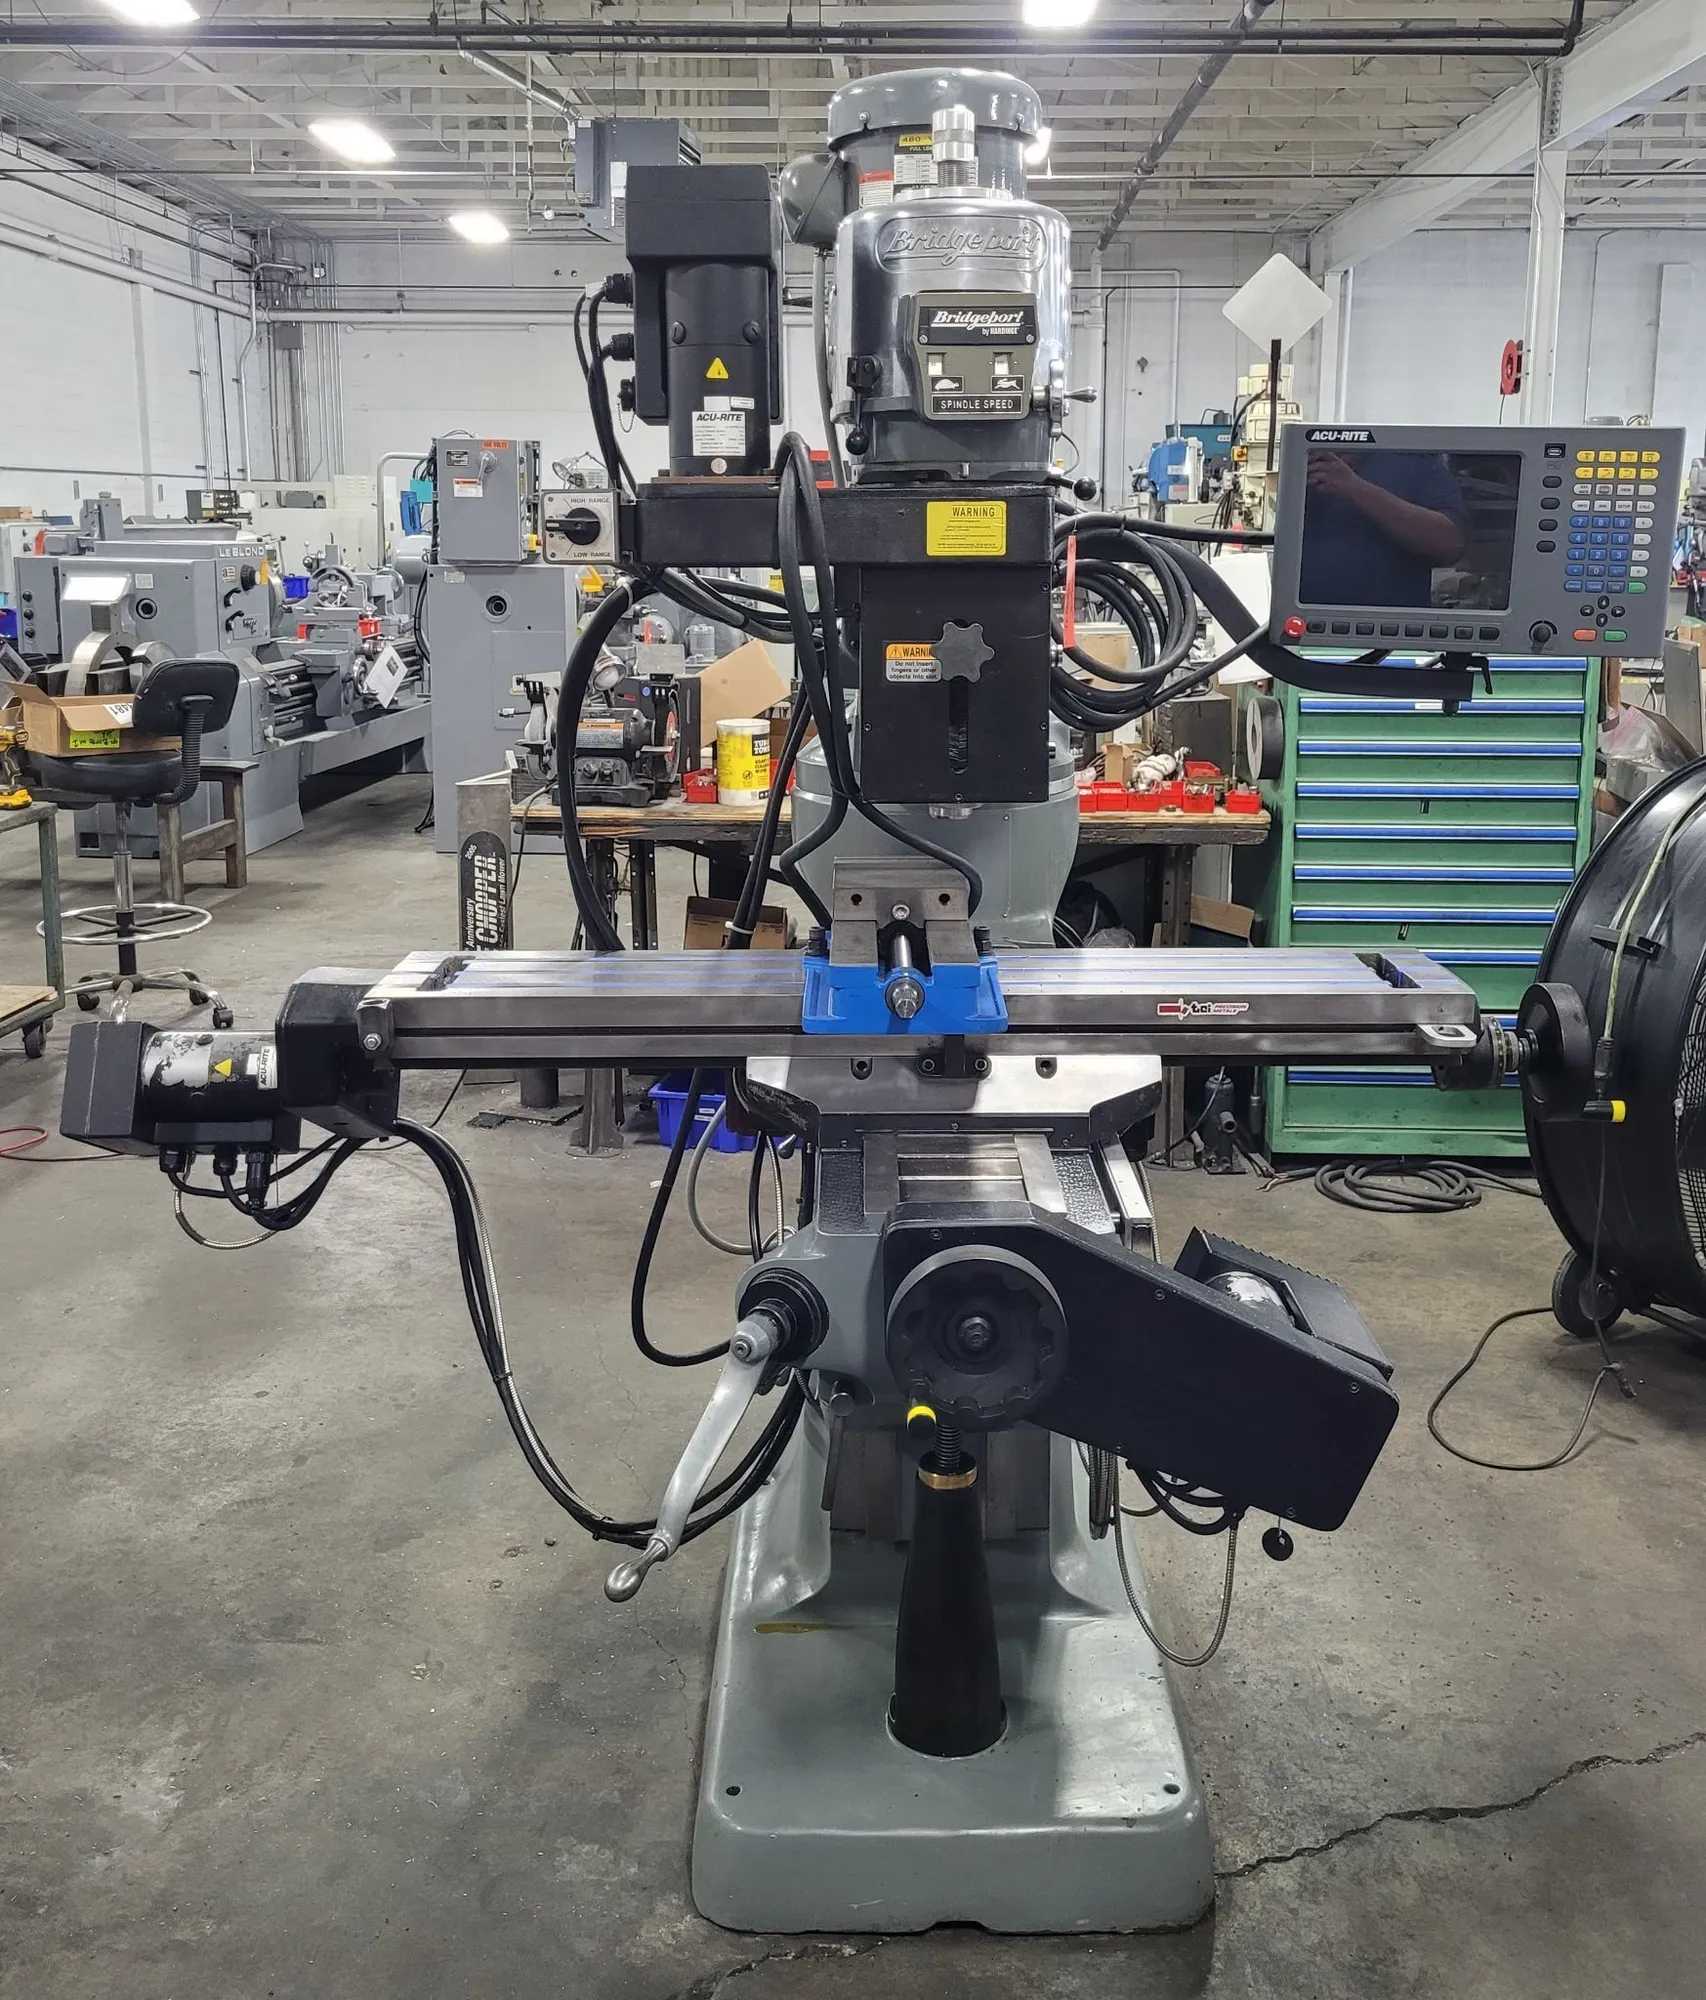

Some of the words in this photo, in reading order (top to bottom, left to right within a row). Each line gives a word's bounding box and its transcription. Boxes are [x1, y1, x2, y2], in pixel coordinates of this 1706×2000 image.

[882, 221, 1043, 267] Bridgeport
[930, 310, 1024, 331] Bridgeport
[981, 327, 990, 337] by
[940, 399, 981, 410] SPINDLE
[983, 399, 1014, 410] SPEED
[696, 412, 744, 422] ACU-RITE
[1310, 430, 1370, 441] ACU-RITE
[952, 506, 996, 518] WARNING
[474, 855, 498, 944] CHOPPER
[465, 897, 476, 948] Anniversary
[260, 1048, 270, 1086] ACU-RITE
